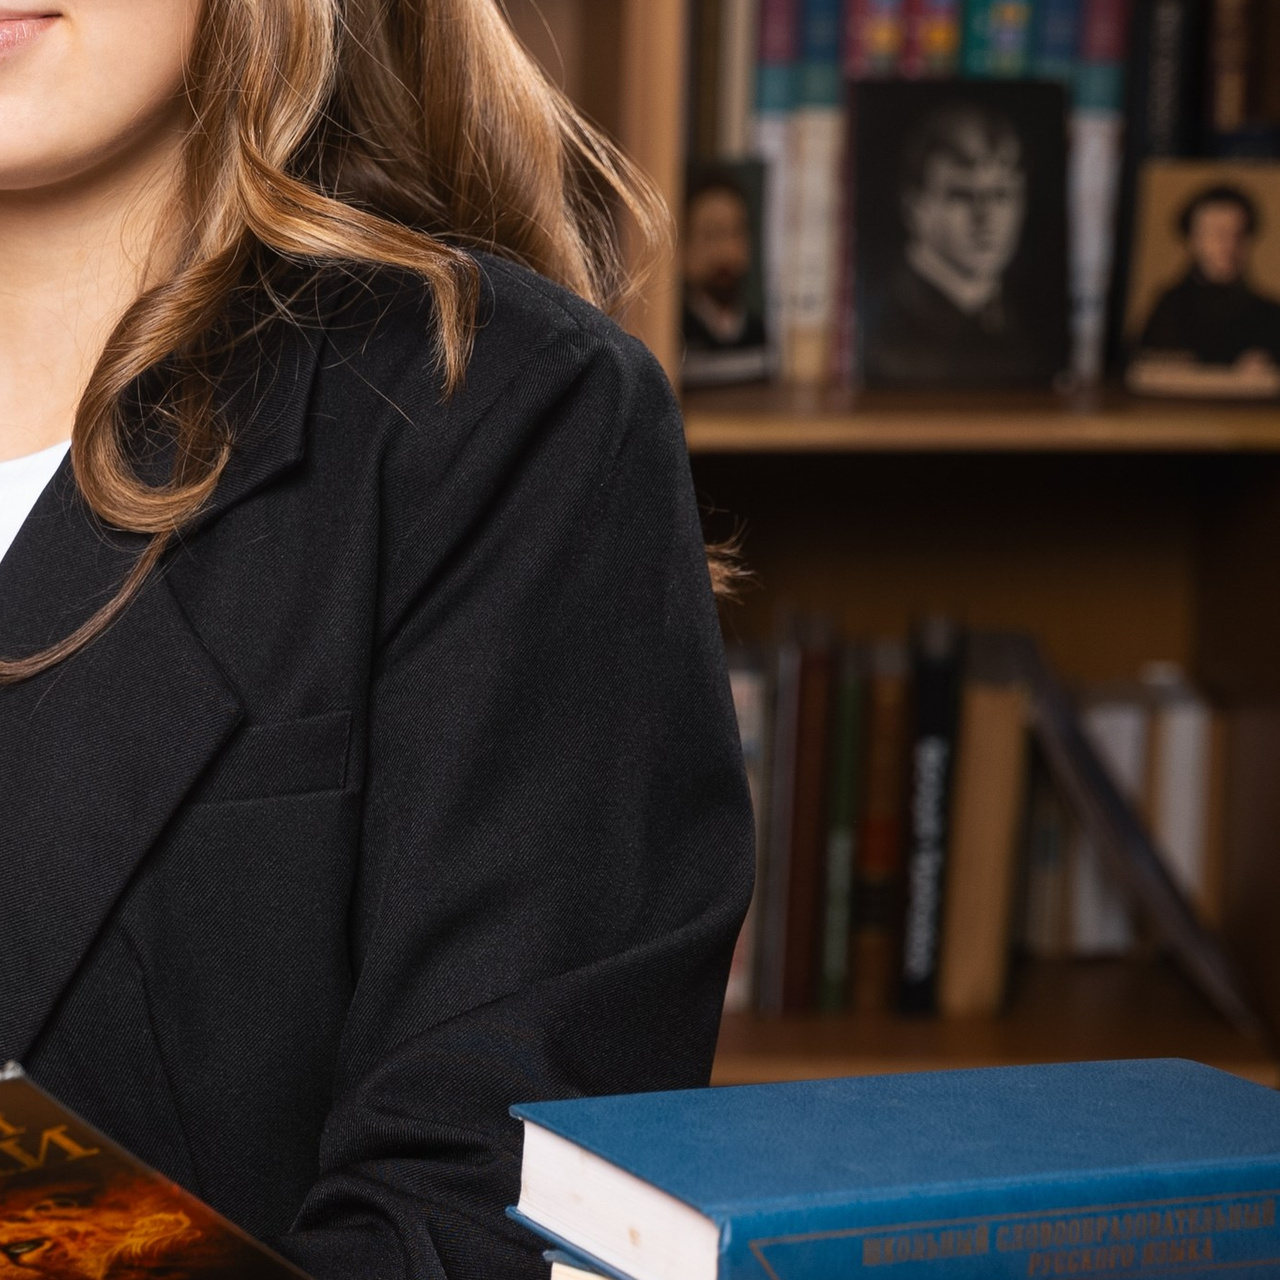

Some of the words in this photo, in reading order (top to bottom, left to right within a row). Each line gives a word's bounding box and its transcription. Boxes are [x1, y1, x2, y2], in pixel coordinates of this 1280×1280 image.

[862, 1225, 989, 1266] ШКОЛЬНЫЙ
[996, 1198, 1275, 1251] СЛОВООБРАЗОВАТЕЛЬНЫЙ
[1028, 1245, 1136, 1276] РУССКОГО
[1142, 1236, 1214, 1264] ЯЗЫКА
